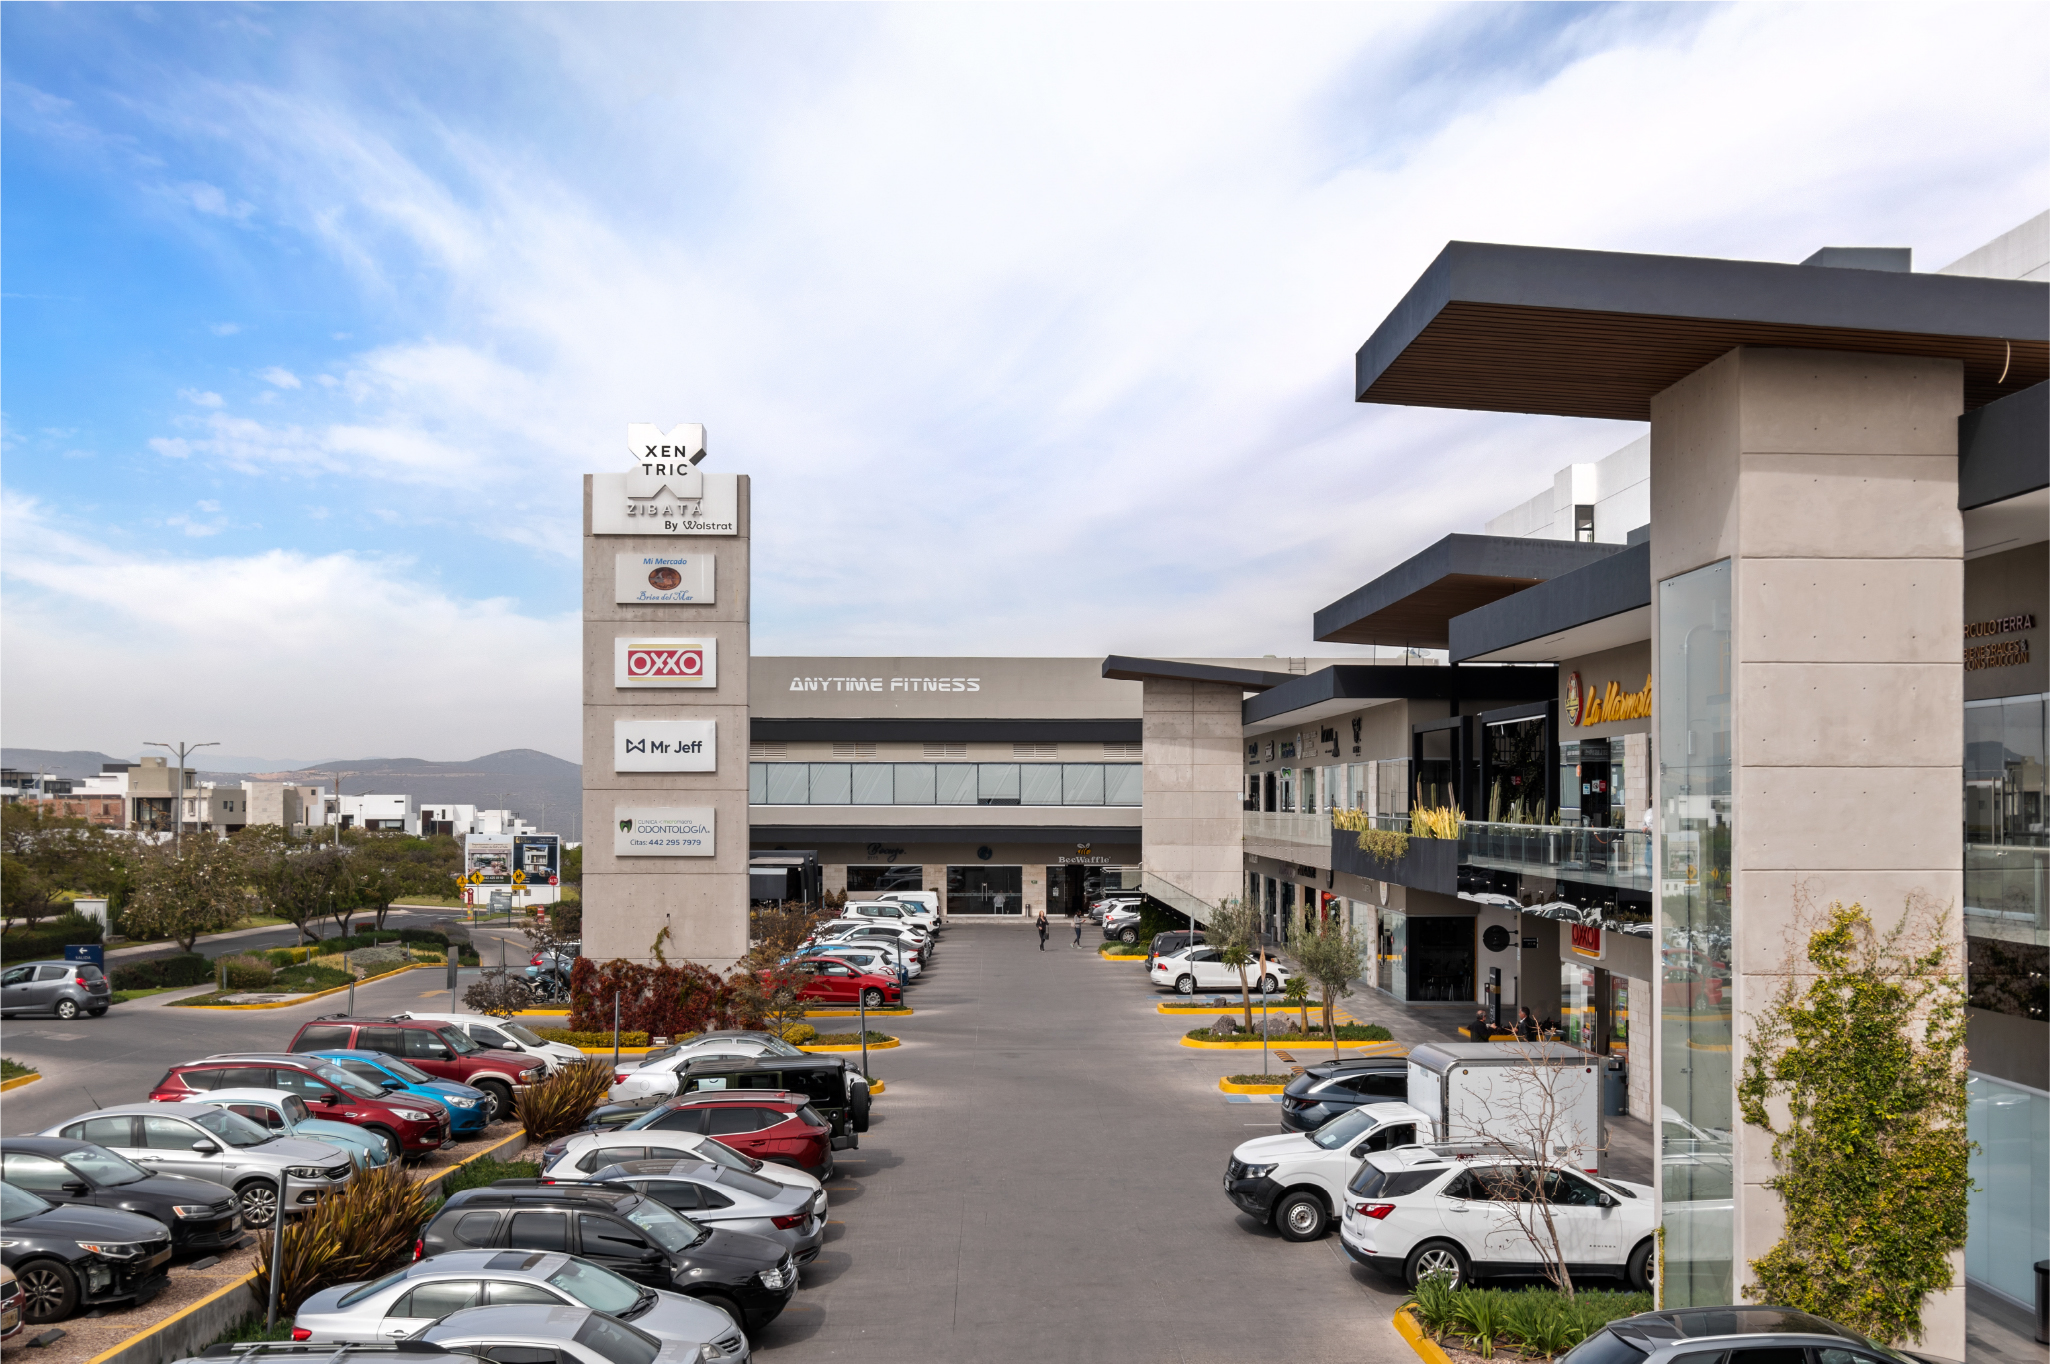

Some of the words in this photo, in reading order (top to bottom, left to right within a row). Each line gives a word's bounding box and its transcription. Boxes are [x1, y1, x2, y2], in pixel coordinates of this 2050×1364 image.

[645, 445, 686, 458] XEN
[642, 463, 688, 476] TRIC
[664, 520, 679, 532] By
[683, 520, 733, 531] Wolstrat
[661, 593, 673, 601] del
[672, 589, 694, 601] Mar
[1964, 614, 2033, 638] RCULOTERRA
[629, 652, 701, 674] OXXO
[789, 677, 883, 692] ANYTIME
[890, 677, 981, 692] FITNESS
[1582, 685, 1603, 727] La
[651, 740, 671, 754] Mr
[674, 740, 703, 754] Jeff
